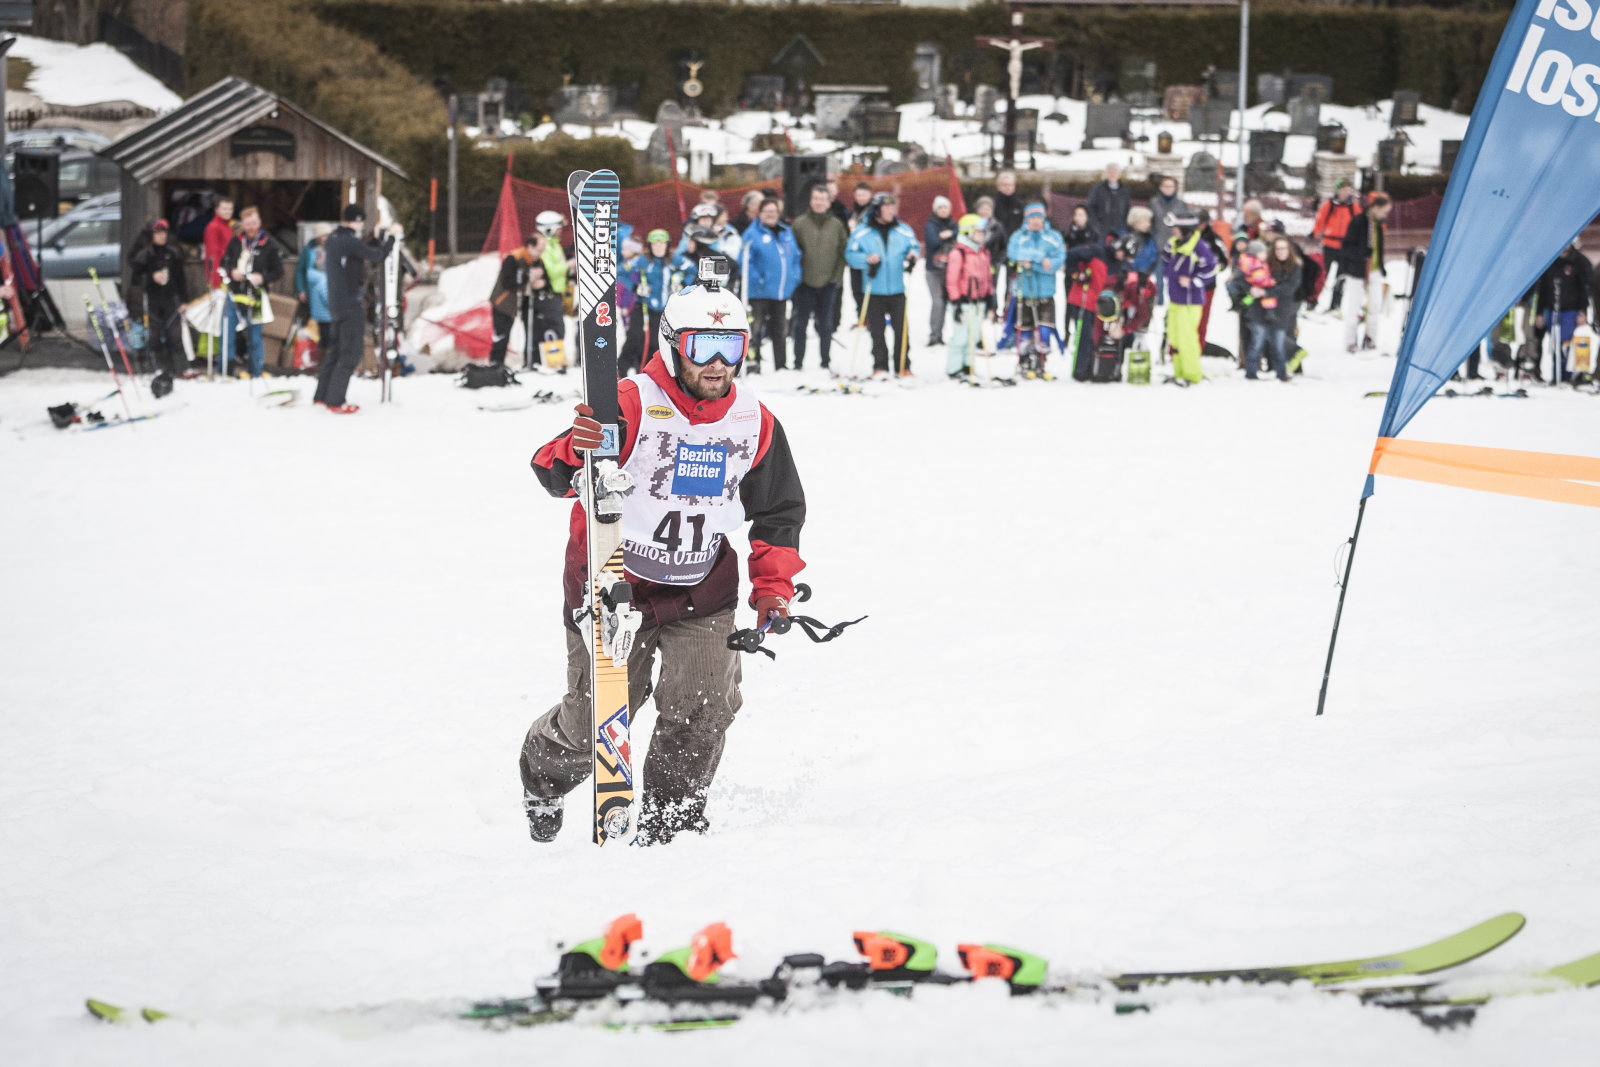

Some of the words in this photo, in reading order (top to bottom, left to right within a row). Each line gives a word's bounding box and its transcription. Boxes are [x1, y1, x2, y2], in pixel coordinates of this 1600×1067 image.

[1506, 23, 1600, 123] los
[679, 447, 724, 463] Bezirks
[677, 463, 720, 478] Blätter
[652, 510, 706, 552] 41
